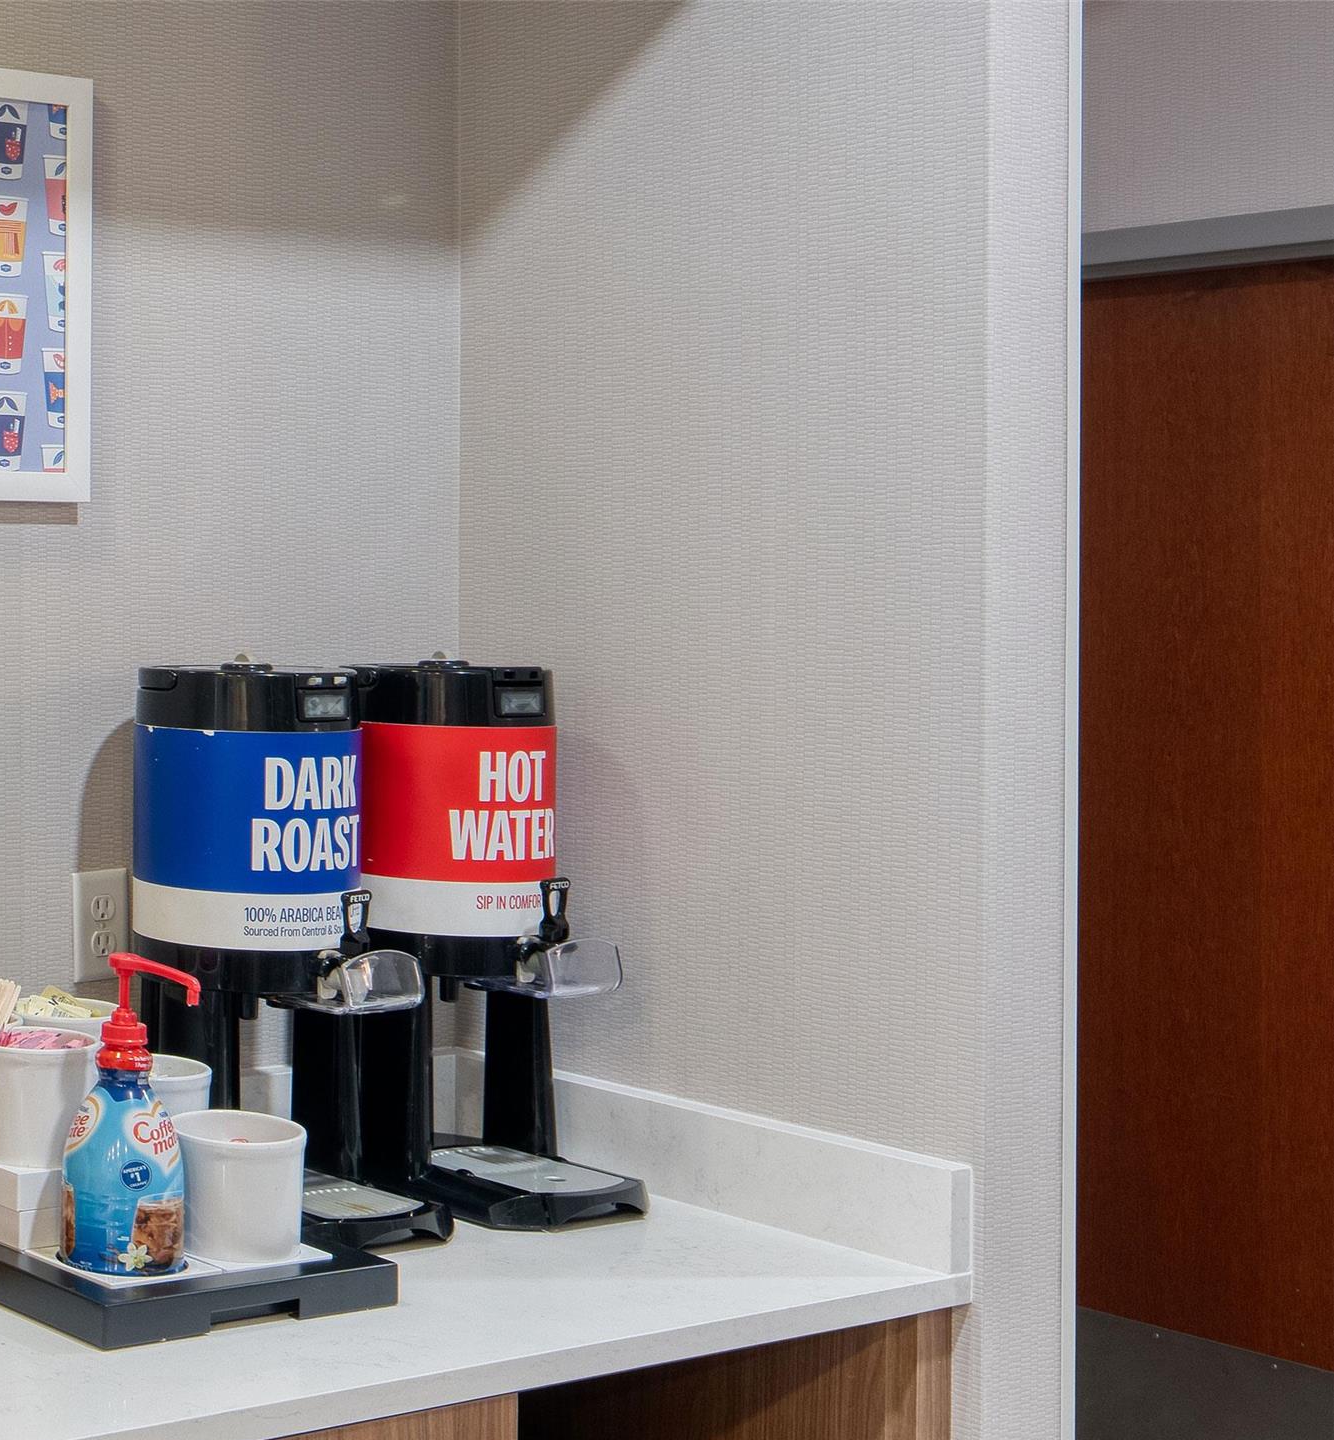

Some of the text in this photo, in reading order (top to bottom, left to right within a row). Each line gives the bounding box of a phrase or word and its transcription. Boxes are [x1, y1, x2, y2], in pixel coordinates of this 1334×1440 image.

[264, 755, 357, 811] DARK
[479, 750, 546, 803] HOT
[251, 814, 359, 873] ROAST
[449, 808, 554, 861] WATER
[349, 893, 370, 903] FETCO
[476, 894, 542, 910] SIP IN COMFOR
[244, 906, 277, 923] 100%
[279, 906, 324, 923] ARABICA
[326, 905, 342, 921] BEA
[243, 925, 279, 937] Sourced
[280, 926, 301, 938] From
[302, 925, 327, 937] Central
[133, 1119, 174, 1144] Coffe
